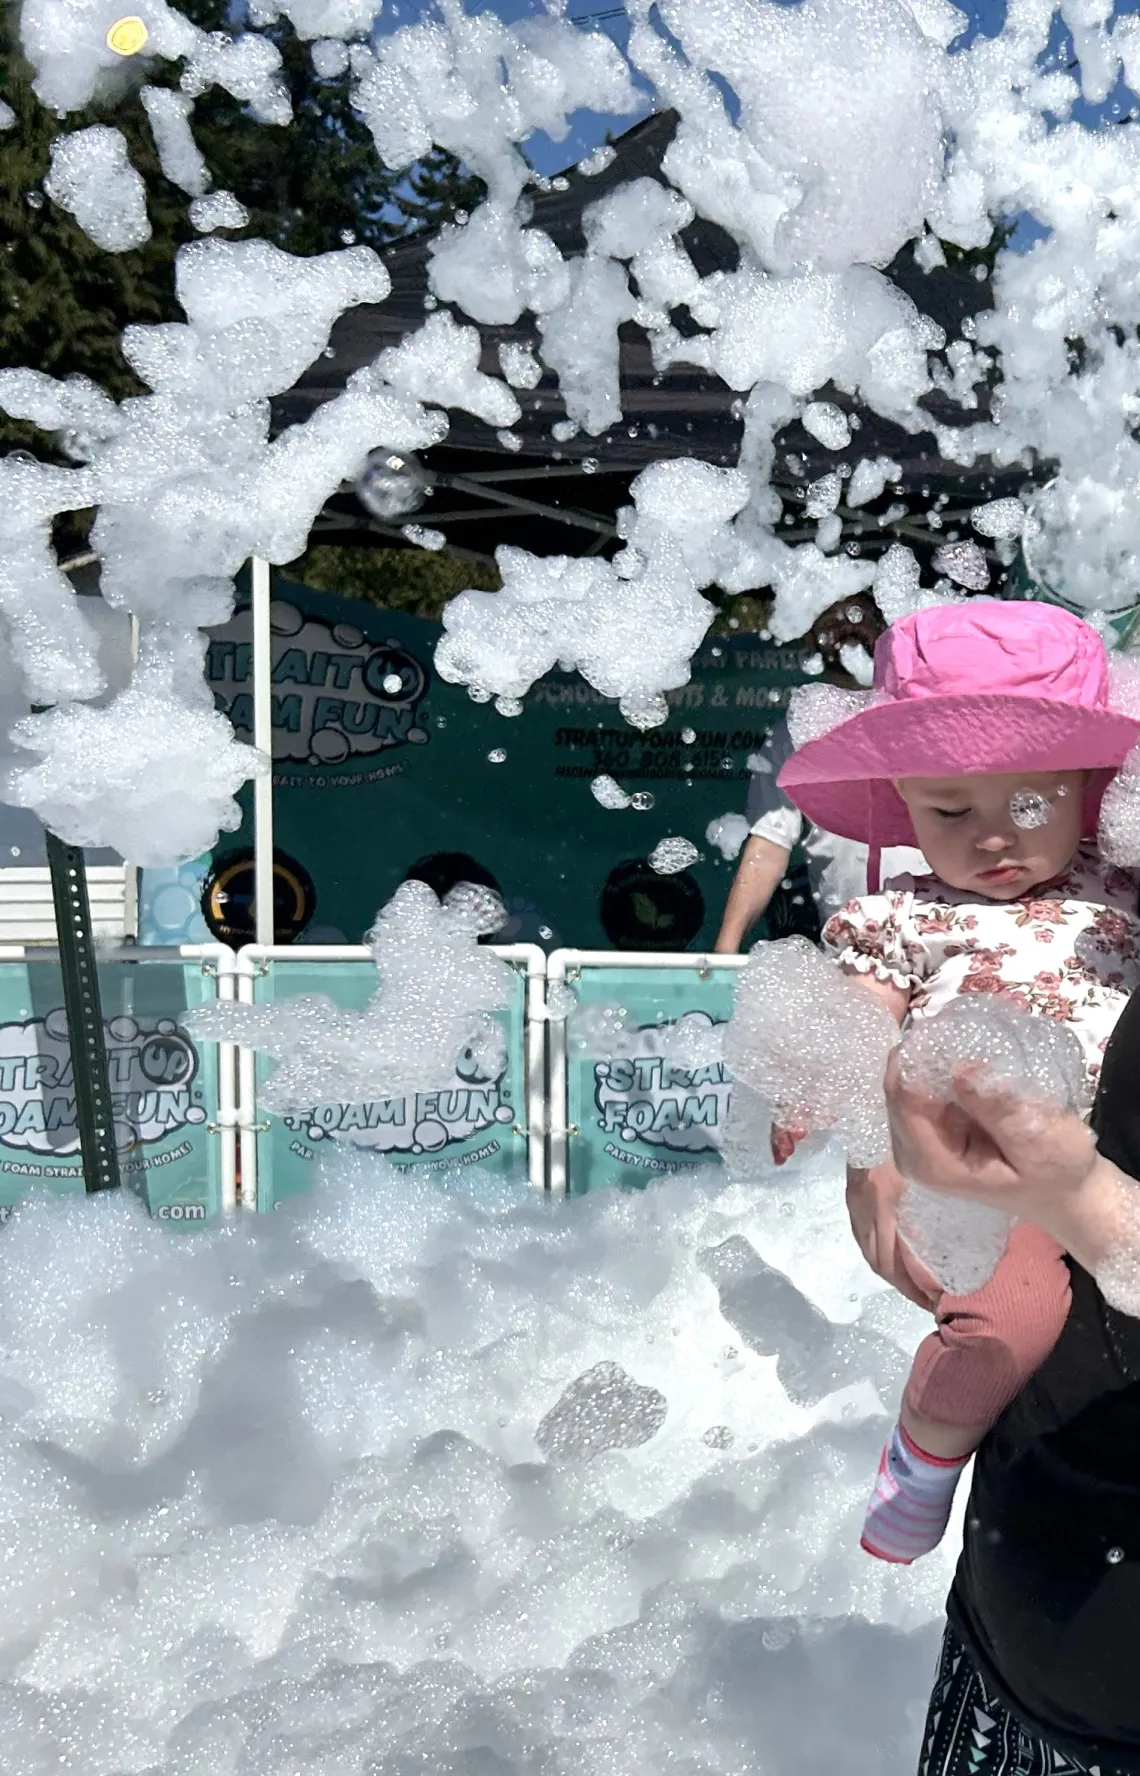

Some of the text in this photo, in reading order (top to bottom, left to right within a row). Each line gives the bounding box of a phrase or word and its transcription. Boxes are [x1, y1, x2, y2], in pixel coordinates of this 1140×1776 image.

[208, 641, 366, 689] TAIT
[711, 683, 729, 708] &
[214, 693, 414, 742] AM FUN
[272, 774, 303, 788] RAIT
[0, 1044, 189, 1092] TRT UP
[606, 1056, 733, 1092] STRA
[0, 1090, 190, 1135] OAM FUN
[416, 1089, 500, 1124] FUN
[603, 1094, 719, 1134] FOAM
[3, 1142, 194, 1178] FOAM STRAI YOUR HOME!
[290, 1140, 314, 1160] PAR
[463, 1140, 501, 1165] HOME!
[604, 1142, 641, 1167] PARTY
[643, 1157, 678, 1172] FOAM
